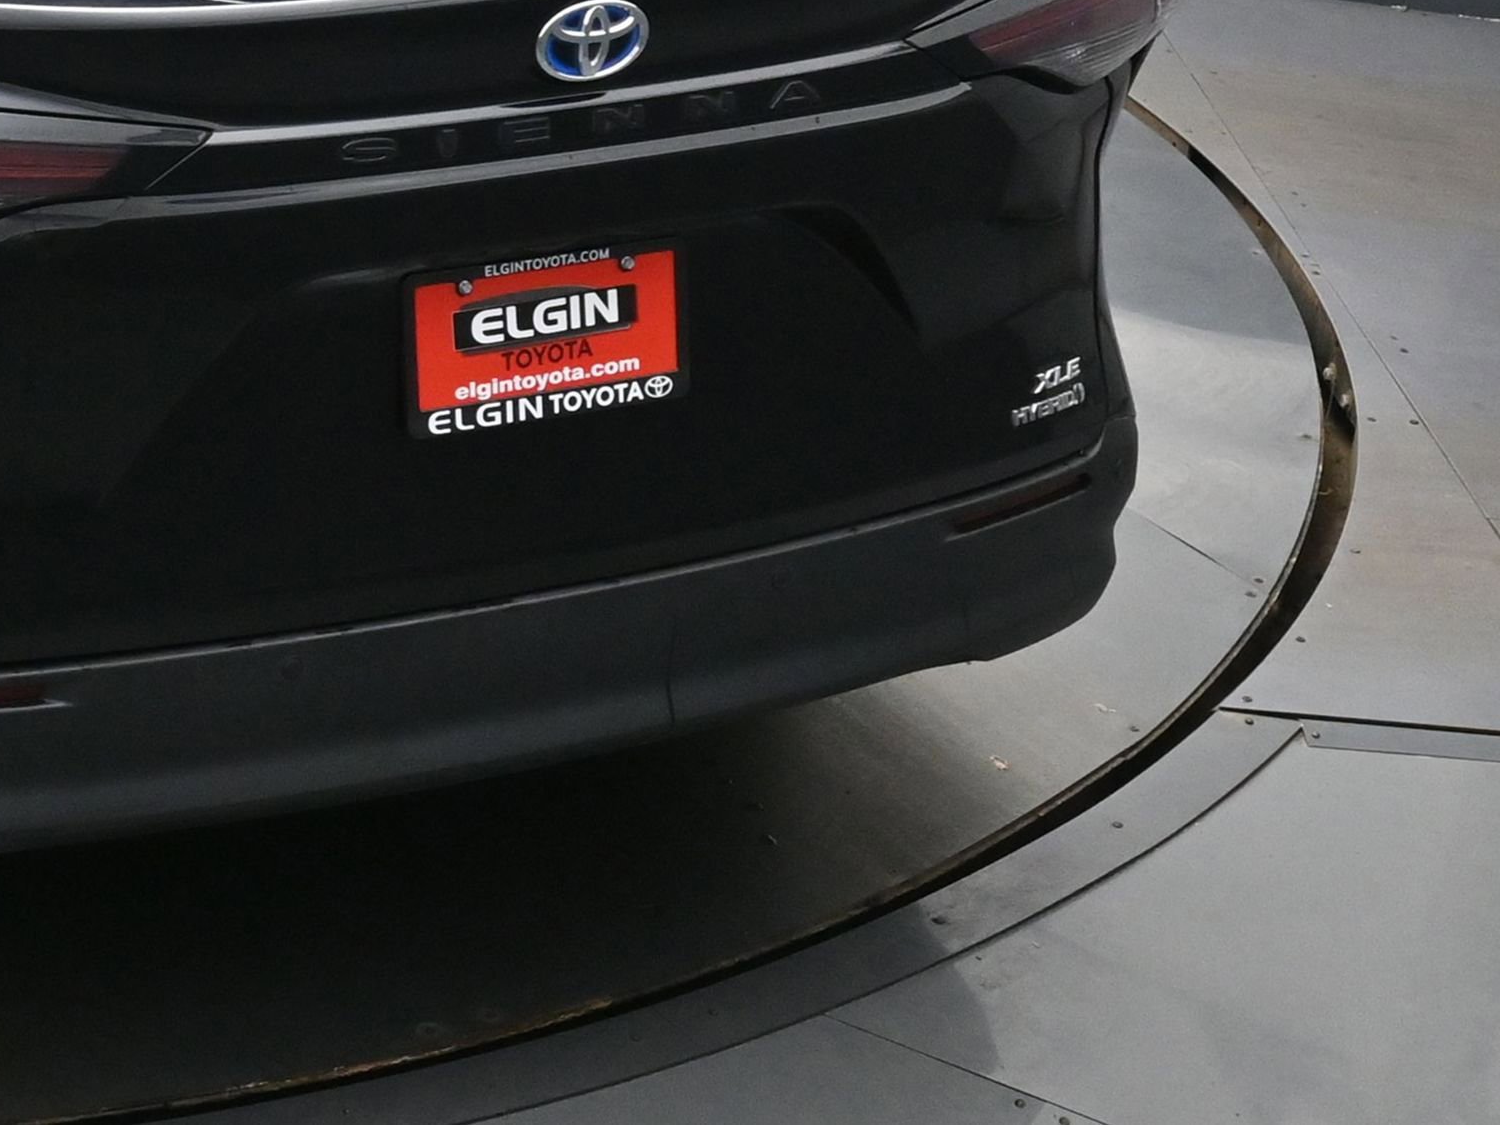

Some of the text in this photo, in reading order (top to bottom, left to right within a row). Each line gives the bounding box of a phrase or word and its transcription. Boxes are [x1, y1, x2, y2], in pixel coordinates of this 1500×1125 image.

[341, 79, 820, 162] SIENNA
[484, 249, 610, 277] ELGINTOYOTA.COM
[470, 288, 619, 344] ELGIN
[501, 339, 593, 371] TOYOTA
[1033, 356, 1081, 394] XLE
[454, 358, 640, 401] elgintoyota.com
[427, 381, 644, 435] ELGIN TOYOTA
